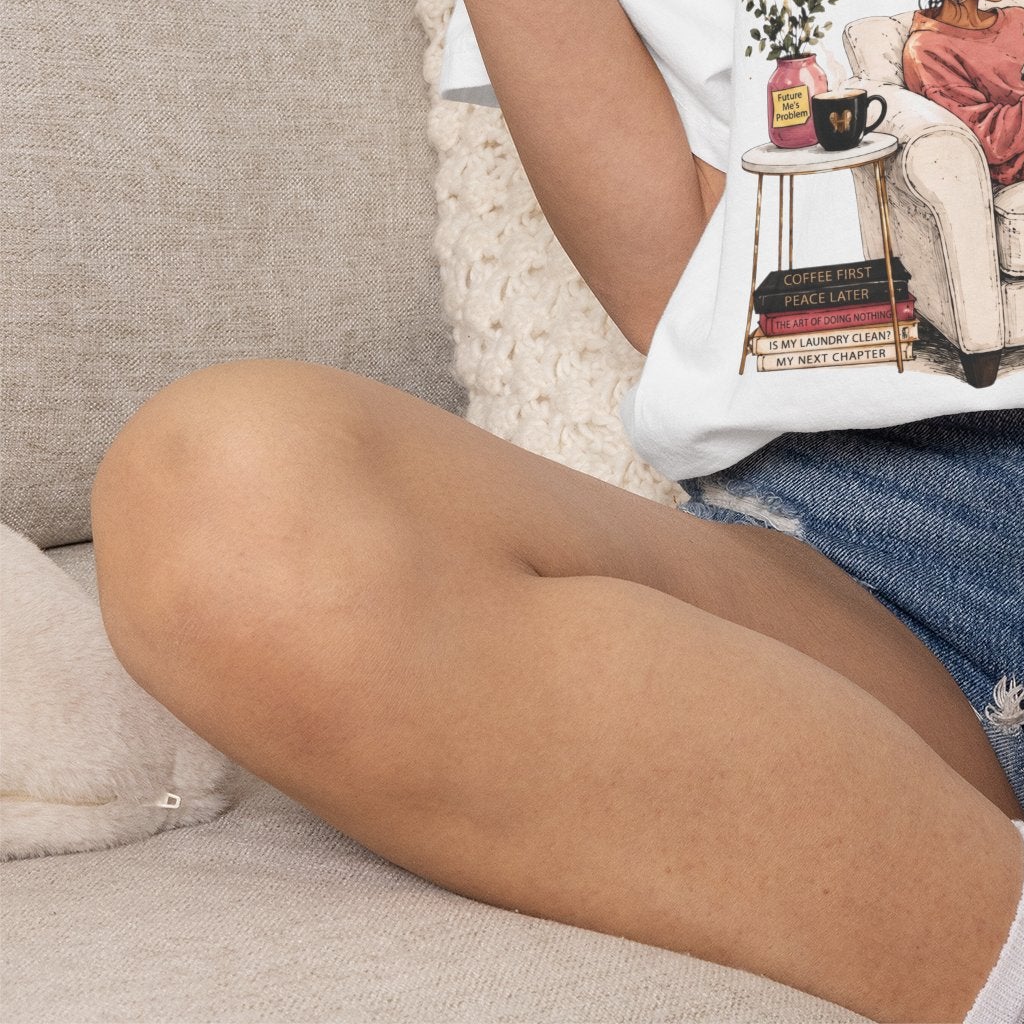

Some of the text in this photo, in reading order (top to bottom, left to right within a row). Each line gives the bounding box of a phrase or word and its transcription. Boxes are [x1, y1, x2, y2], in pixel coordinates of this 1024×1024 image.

[777, 91, 803, 102] Future
[776, 110, 808, 121] Problem
[782, 102, 800, 111] Me's
[784, 266, 872, 286] COFFEE FIRST
[784, 288, 869, 307] PEACE LATER
[776, 310, 893, 329] THE ART OF DOING NOTHING
[769, 330, 891, 350] IS MY LAUNDRY CLEAN?
[776, 348, 886, 367] MY NEXT CHAPTER
